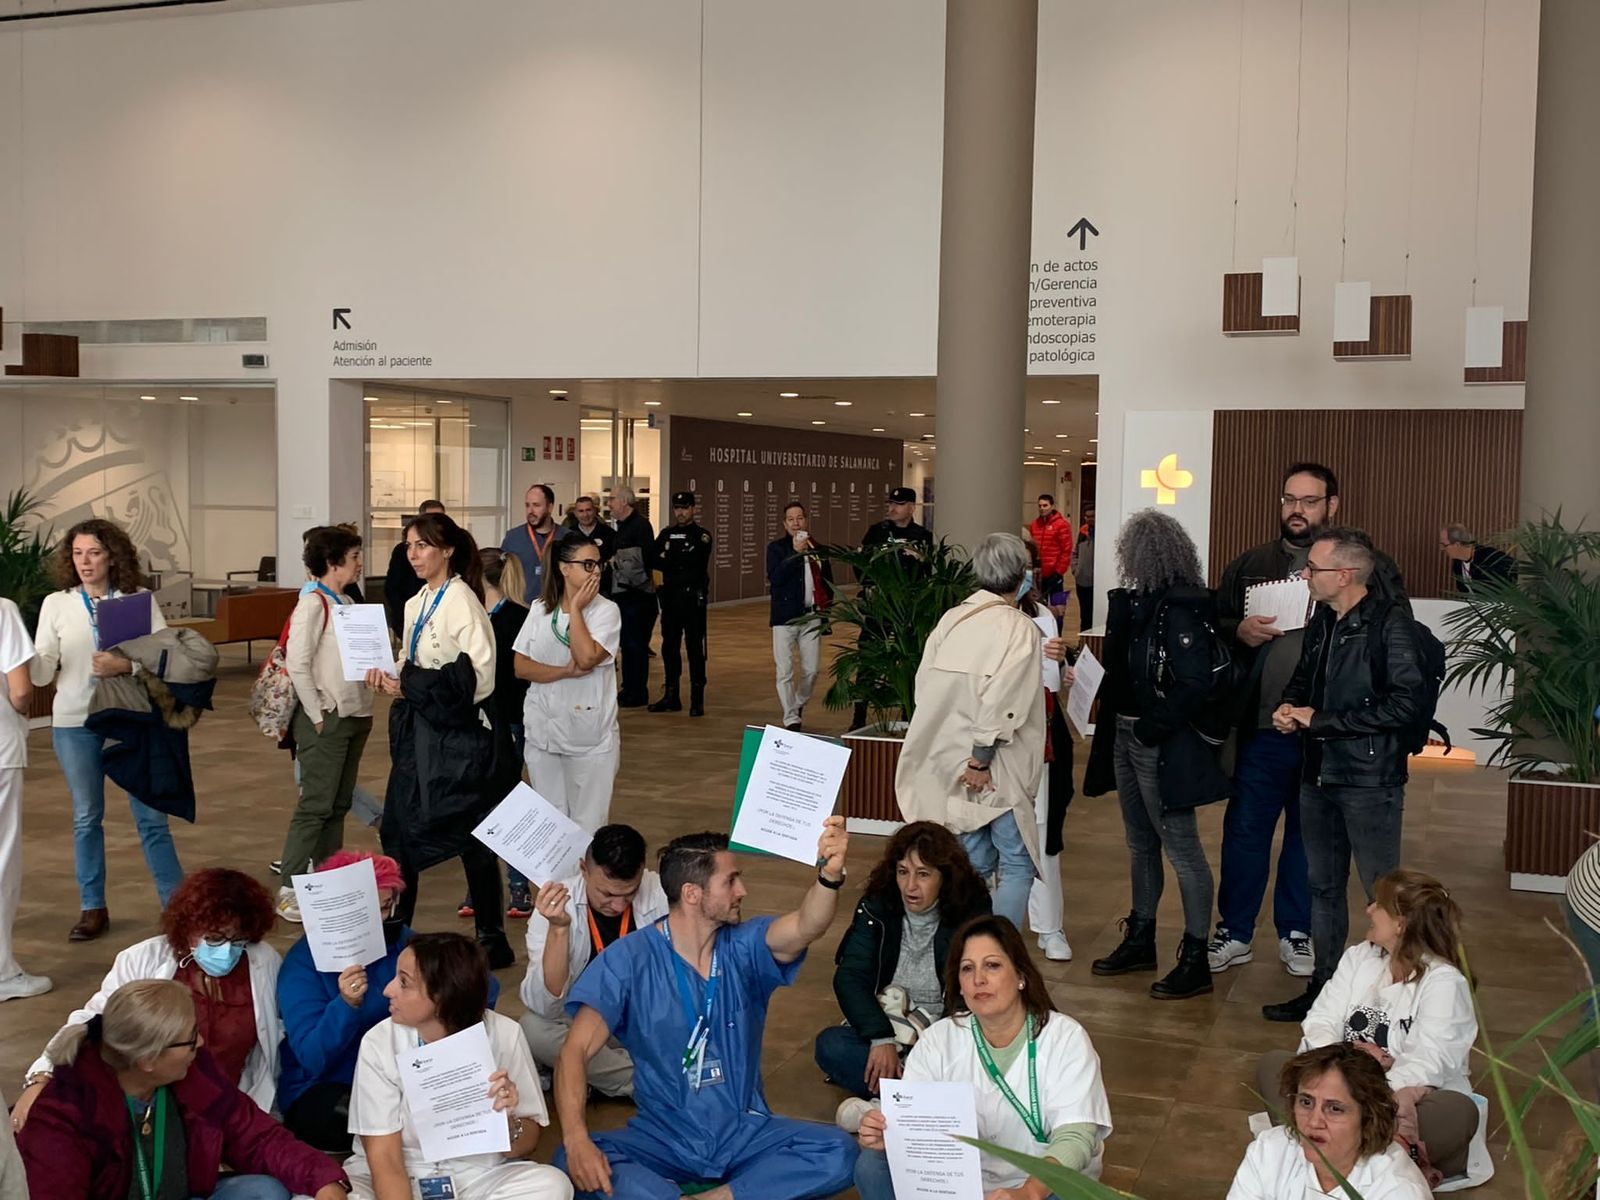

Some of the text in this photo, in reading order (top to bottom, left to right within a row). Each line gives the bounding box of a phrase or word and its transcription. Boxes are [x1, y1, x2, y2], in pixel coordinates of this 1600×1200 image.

[1044, 260, 1060, 272] de
[1064, 260, 1098, 272] actos
[1030, 296, 1096, 311] preventiva
[333, 340, 377, 350] Admisión
[333, 355, 432, 368] Atención al paciente
[1029, 348, 1095, 364] patológica
[710, 448, 757, 464] HOSPITAL
[760, 450, 826, 468] UNIVERSITARIO
[828, 456, 838, 468] DE
[840, 456, 880, 470] SALAMANCA
